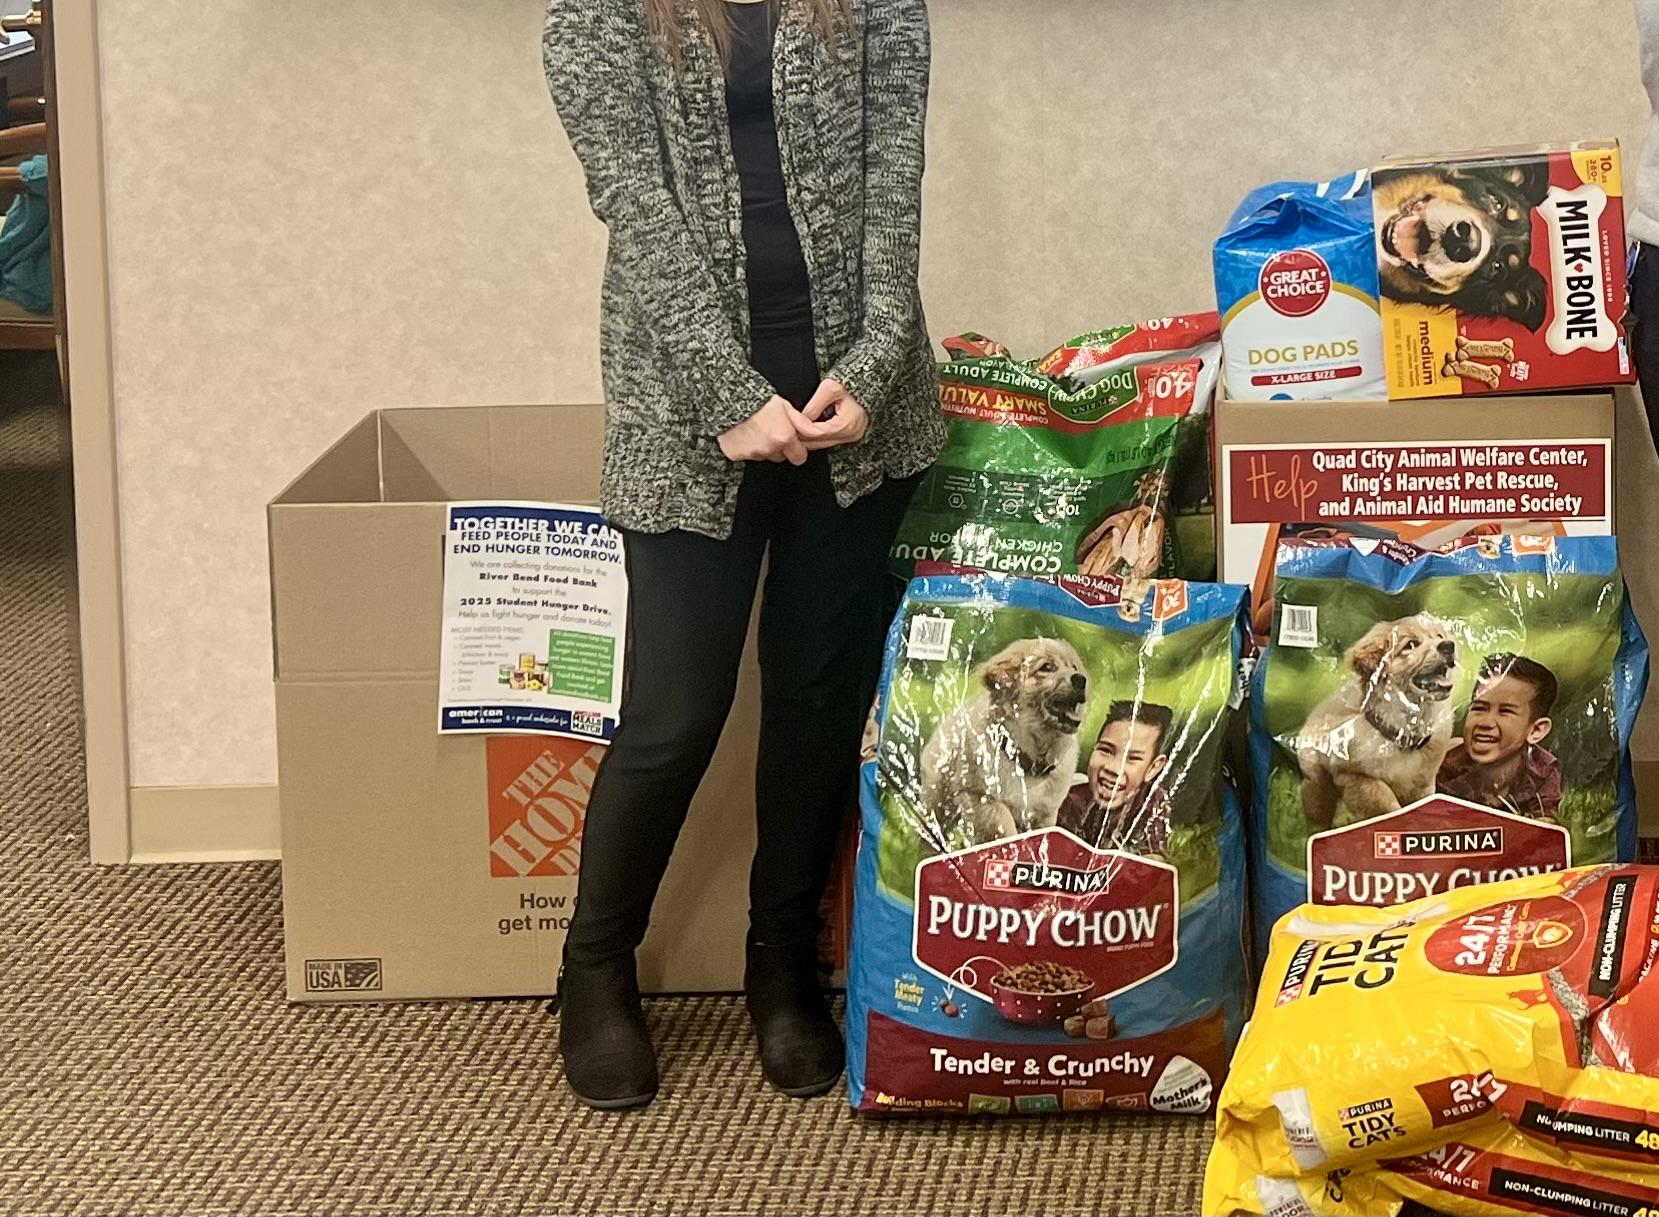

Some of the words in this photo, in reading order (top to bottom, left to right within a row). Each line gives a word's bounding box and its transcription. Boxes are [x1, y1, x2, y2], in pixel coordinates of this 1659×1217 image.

[1600, 155, 1613, 172] 10
[1556, 200, 1592, 266] MILK
[1270, 267, 1320, 285] GREAT
[1267, 280, 1324, 298] CHOICE
[1566, 274, 1598, 340] BONE
[1248, 346, 1297, 366] DOG
[1303, 340, 1359, 361] PADS
[1419, 320, 1433, 386] medium
[943, 365, 991, 379] ADULT
[992, 370, 1048, 390] COMPLETE
[1101, 371, 1134, 390] DOG
[1271, 372, 1313, 384] X-LARGE
[1314, 369, 1336, 381] SIZE
[1156, 371, 1194, 399] 40
[993, 394, 1047, 416] SMART
[1312, 450, 1356, 472] Quad
[1361, 450, 1394, 472] City
[1398, 448, 1456, 469] Animal
[1460, 447, 1524, 467] Welfare
[1529, 447, 1588, 467] Center,
[1246, 454, 1318, 521] Help
[1342, 473, 1392, 495] King's
[1397, 472, 1460, 492] Harvest
[1465, 471, 1493, 490] Pet
[1497, 471, 1559, 490] Rescue,
[1319, 497, 1350, 517] and
[1353, 495, 1412, 516] Animal
[1415, 494, 1444, 514] Aid
[1449, 495, 1516, 514] Humane
[1521, 493, 1582, 515] Society
[454, 517, 549, 532] TOGETHER
[554, 520, 583, 534] WE
[461, 531, 490, 541] FEED
[496, 532, 541, 543] PEOPLE
[546, 534, 587, 546] TODAY
[591, 538, 617, 550] AND
[996, 537, 1062, 553] CHICKEN
[453, 545, 481, 554] END
[485, 545, 540, 555] HUNGER
[545, 546, 622, 564] TOMORROW.
[480, 572, 508, 581] River
[513, 573, 539, 582] Bend
[544, 575, 568, 584] Food
[573, 577, 597, 588] Bank
[1091, 580, 1120, 595] PUPPY
[460, 598, 491, 607] 2025
[496, 598, 537, 607] Student
[541, 599, 579, 611] Hunger
[502, 750, 566, 806] THE
[491, 744, 606, 876] HOM
[1405, 831, 1496, 854] PURINA
[1015, 867, 1102, 891] PURINA
[1322, 864, 1441, 905] PUPPY
[520, 893, 566, 909] How
[498, 915, 532, 935] get
[927, 896, 1047, 947] PUPPY
[1051, 904, 1161, 947] CHOW
[1599, 908, 1620, 981] NON-CLUMPING
[1614, 882, 1626, 909] LITTER
[1455, 914, 1494, 967] 24/7
[310, 970, 342, 988] USA
[1309, 940, 1363, 997] TID
[930, 1048, 1016, 1076] Tender
[1024, 1057, 1040, 1076] &
[1048, 1052, 1155, 1078] Crunchy
[924, 1098, 964, 1109] Blocks
[1170, 1097, 1202, 1112] Milk
[1350, 1100, 1391, 1117] PURINA
[1342, 1112, 1397, 1138] TIDY
[1595, 1128, 1630, 1144] LITTER
[1348, 1126, 1407, 1150] CATS
[1504, 1180, 1591, 1208] NON-CLUMPING
[1593, 1199, 1630, 1217] LITTER
